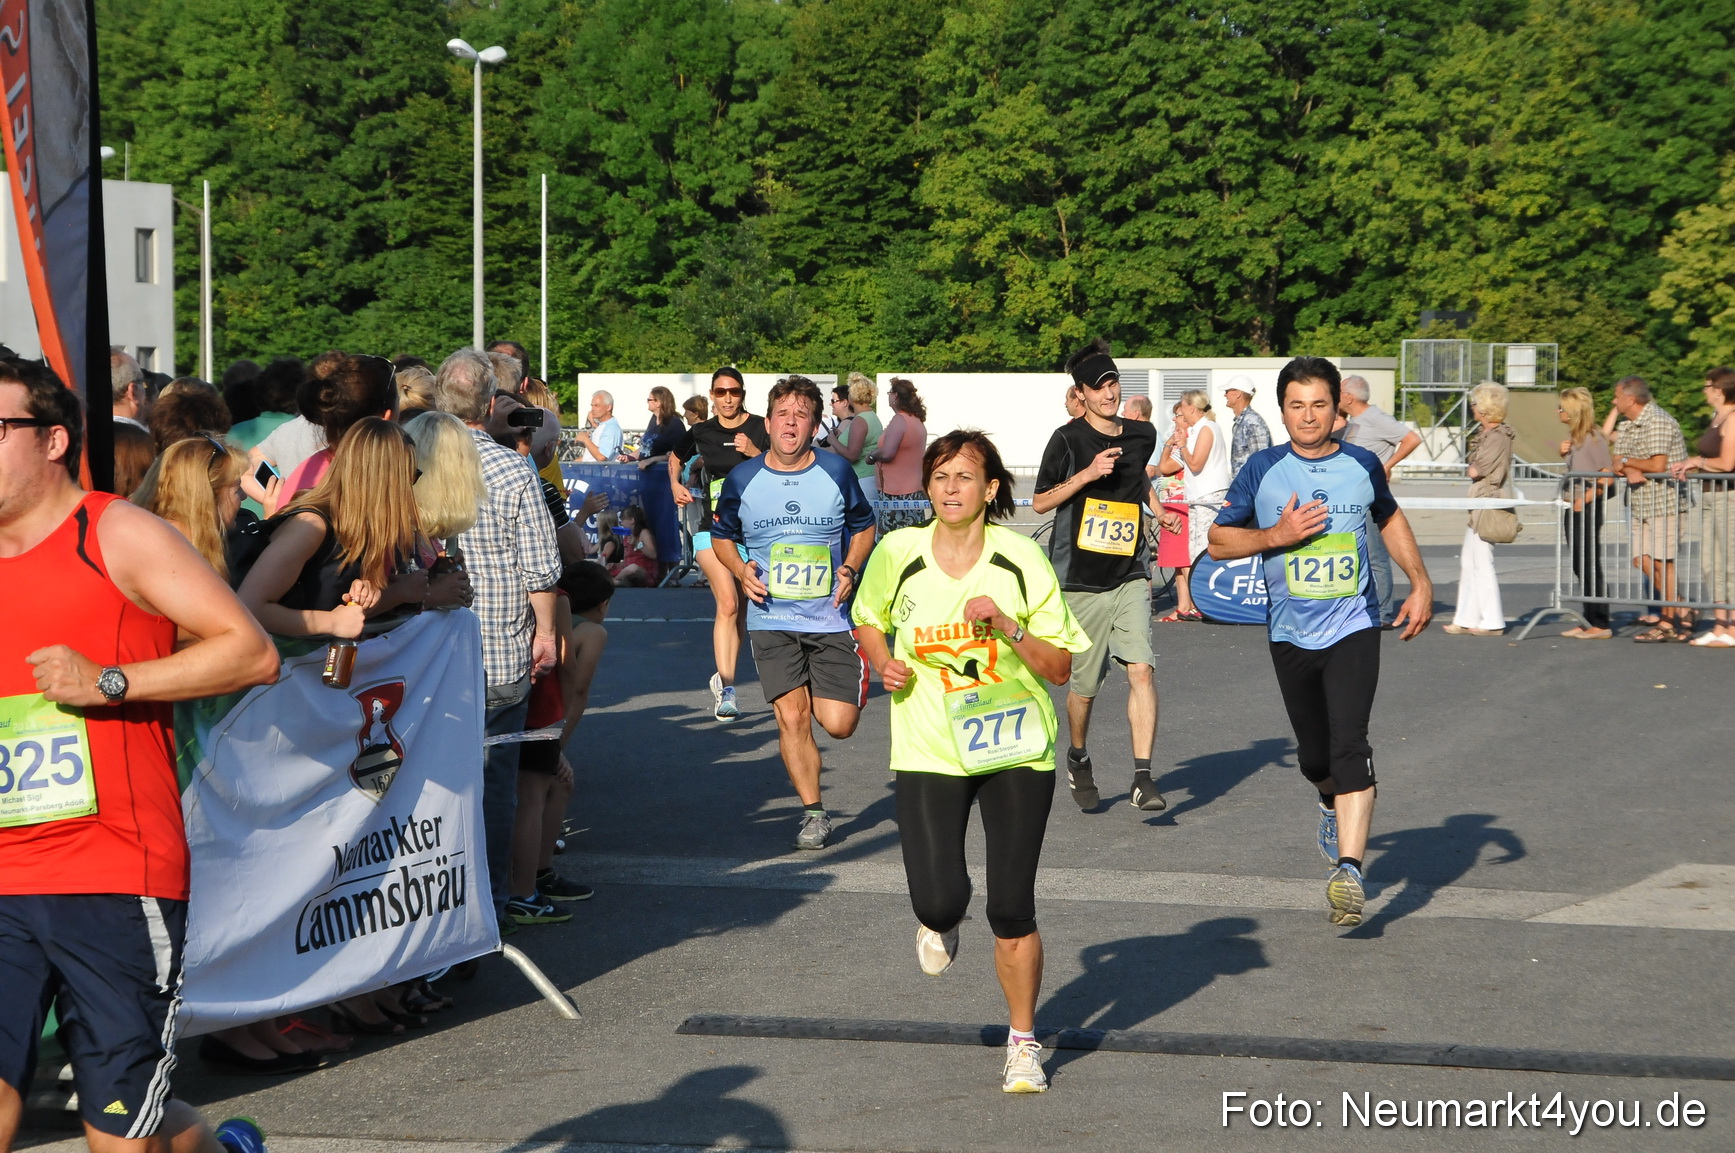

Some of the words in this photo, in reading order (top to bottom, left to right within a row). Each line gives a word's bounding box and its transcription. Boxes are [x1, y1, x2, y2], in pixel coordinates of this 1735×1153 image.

[753, 515, 834, 530] SCHABMÜLLER
[1276, 504, 1363, 516] SÜLLER
[1084, 517, 1135, 543] 1133
[772, 562, 828, 586] 1217
[1288, 556, 1355, 582] 1213
[914, 619, 995, 644] Müller
[963, 707, 1027, 752] 277
[2, 796, 26, 804] Michael
[27, 793, 42, 803] Sigl
[295, 854, 466, 955] Lammsbräu
